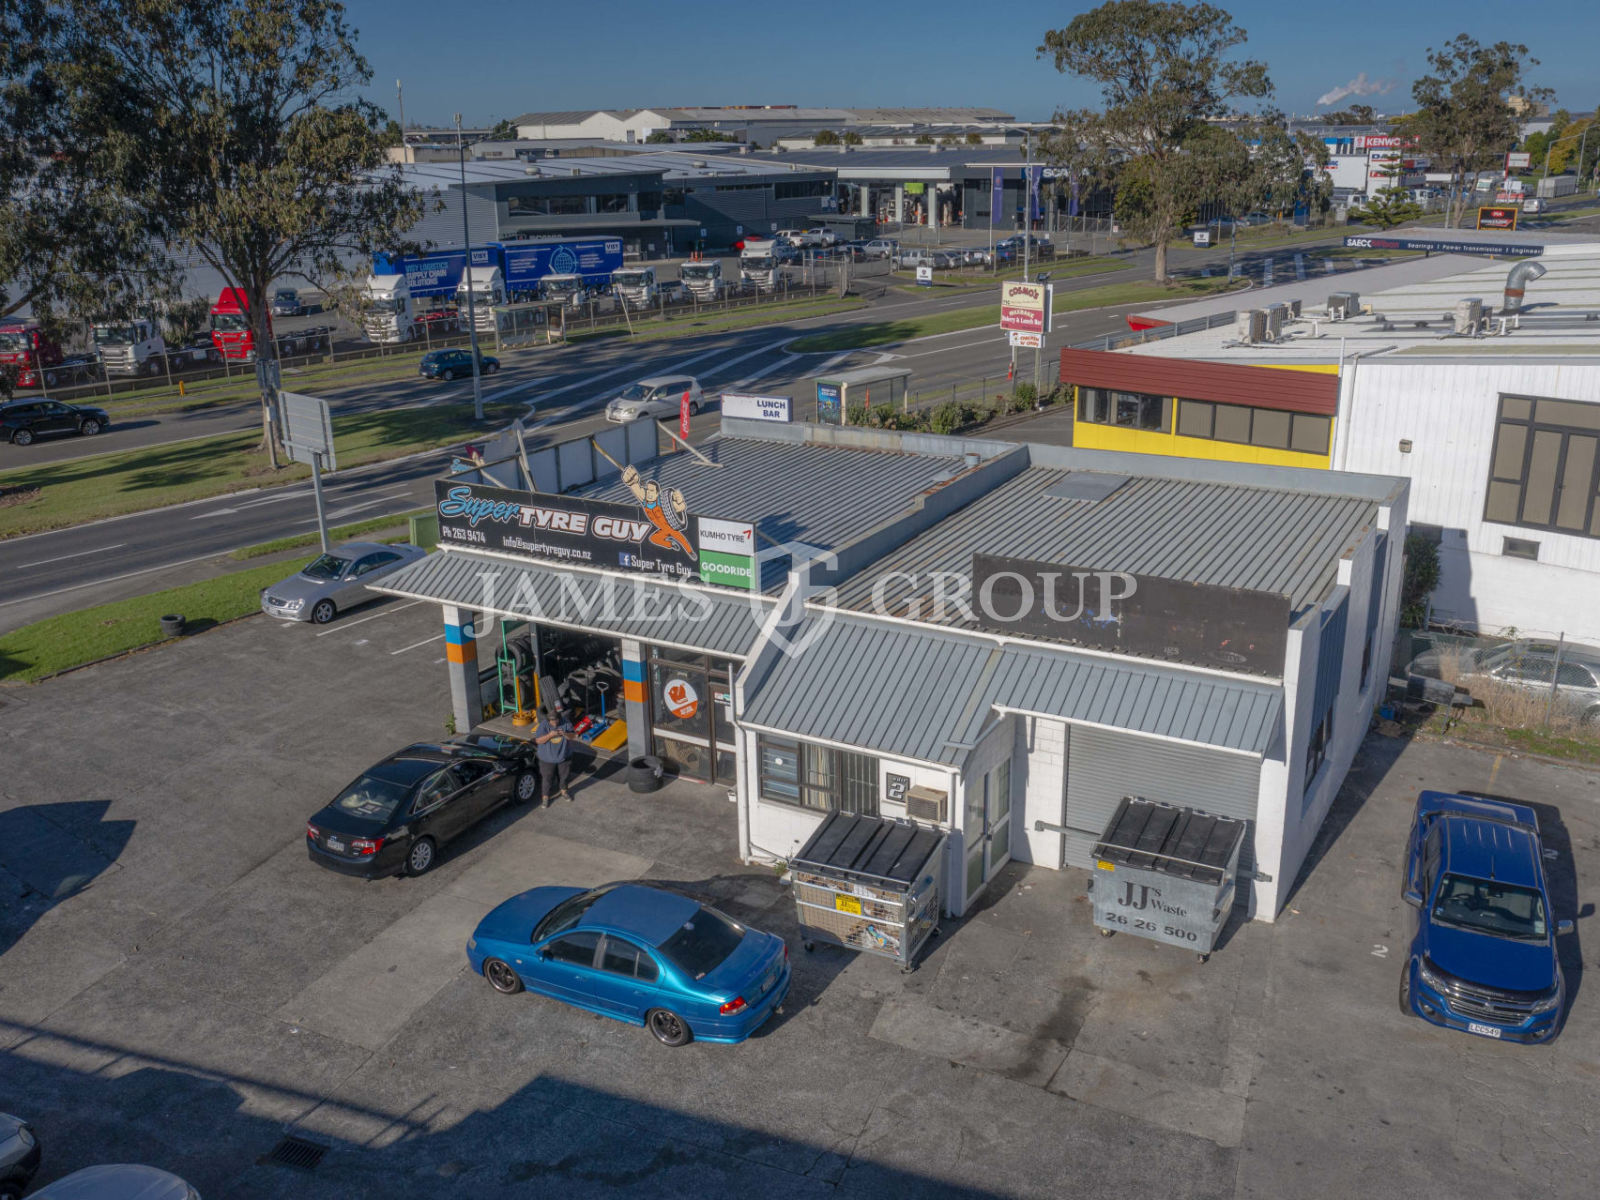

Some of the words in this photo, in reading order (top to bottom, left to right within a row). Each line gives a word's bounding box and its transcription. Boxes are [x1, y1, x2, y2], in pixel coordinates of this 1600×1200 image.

[1366, 136, 1419, 147] KENWO
[1043, 168, 1090, 178] SCAA
[756, 399, 786, 409] LUNCH
[762, 408, 780, 418] BAR
[439, 485, 520, 527] Super
[519, 506, 590, 536] TYRE
[592, 515, 653, 543] GUY
[442, 526, 452, 538] Ph
[453, 527, 467, 540] 263
[468, 529, 486, 543] 9474
[700, 529, 726, 541] KUMHO
[727, 534, 745, 543] TYRE
[503, 536, 592, 560] info@supertyreguy.co.nz
[631, 555, 655, 571] Super
[656, 559, 675, 574] Tyre
[676, 562, 692, 578] Guy
[701, 562, 753, 577] GOODRIDE
[889, 783, 905, 799] 2
[1151, 898, 1188, 918] Waste
[1106, 912, 1128, 925] 26
[1134, 919, 1157, 932] 26
[1163, 926, 1198, 942] 500
